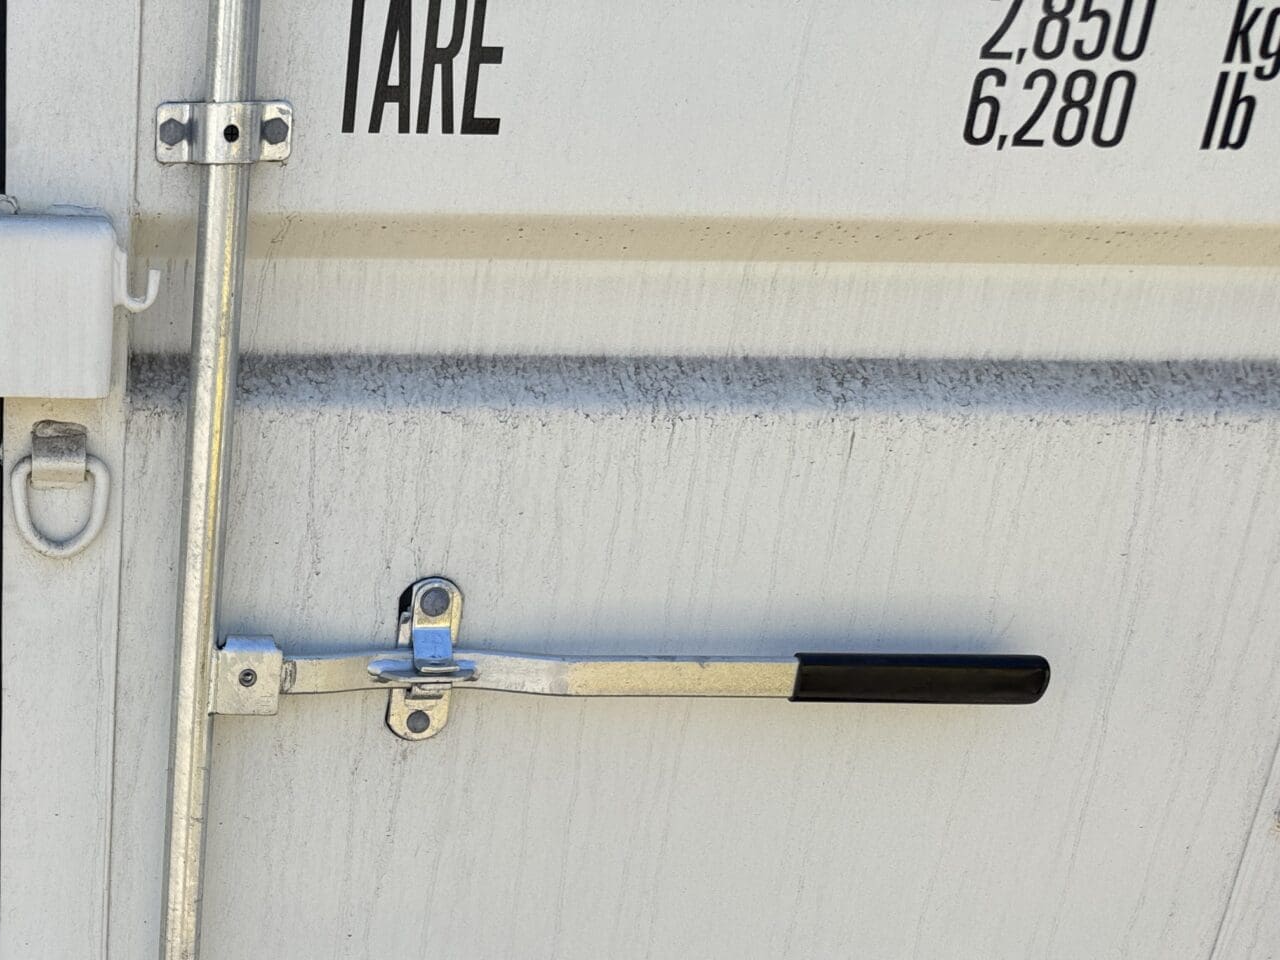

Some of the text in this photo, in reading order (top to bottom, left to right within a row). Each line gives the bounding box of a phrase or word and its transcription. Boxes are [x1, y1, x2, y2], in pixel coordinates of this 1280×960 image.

[341, 0, 504, 135] TARE
[979, 0, 1158, 64] 2,850
[963, 67, 1257, 150] 6,280 lb
